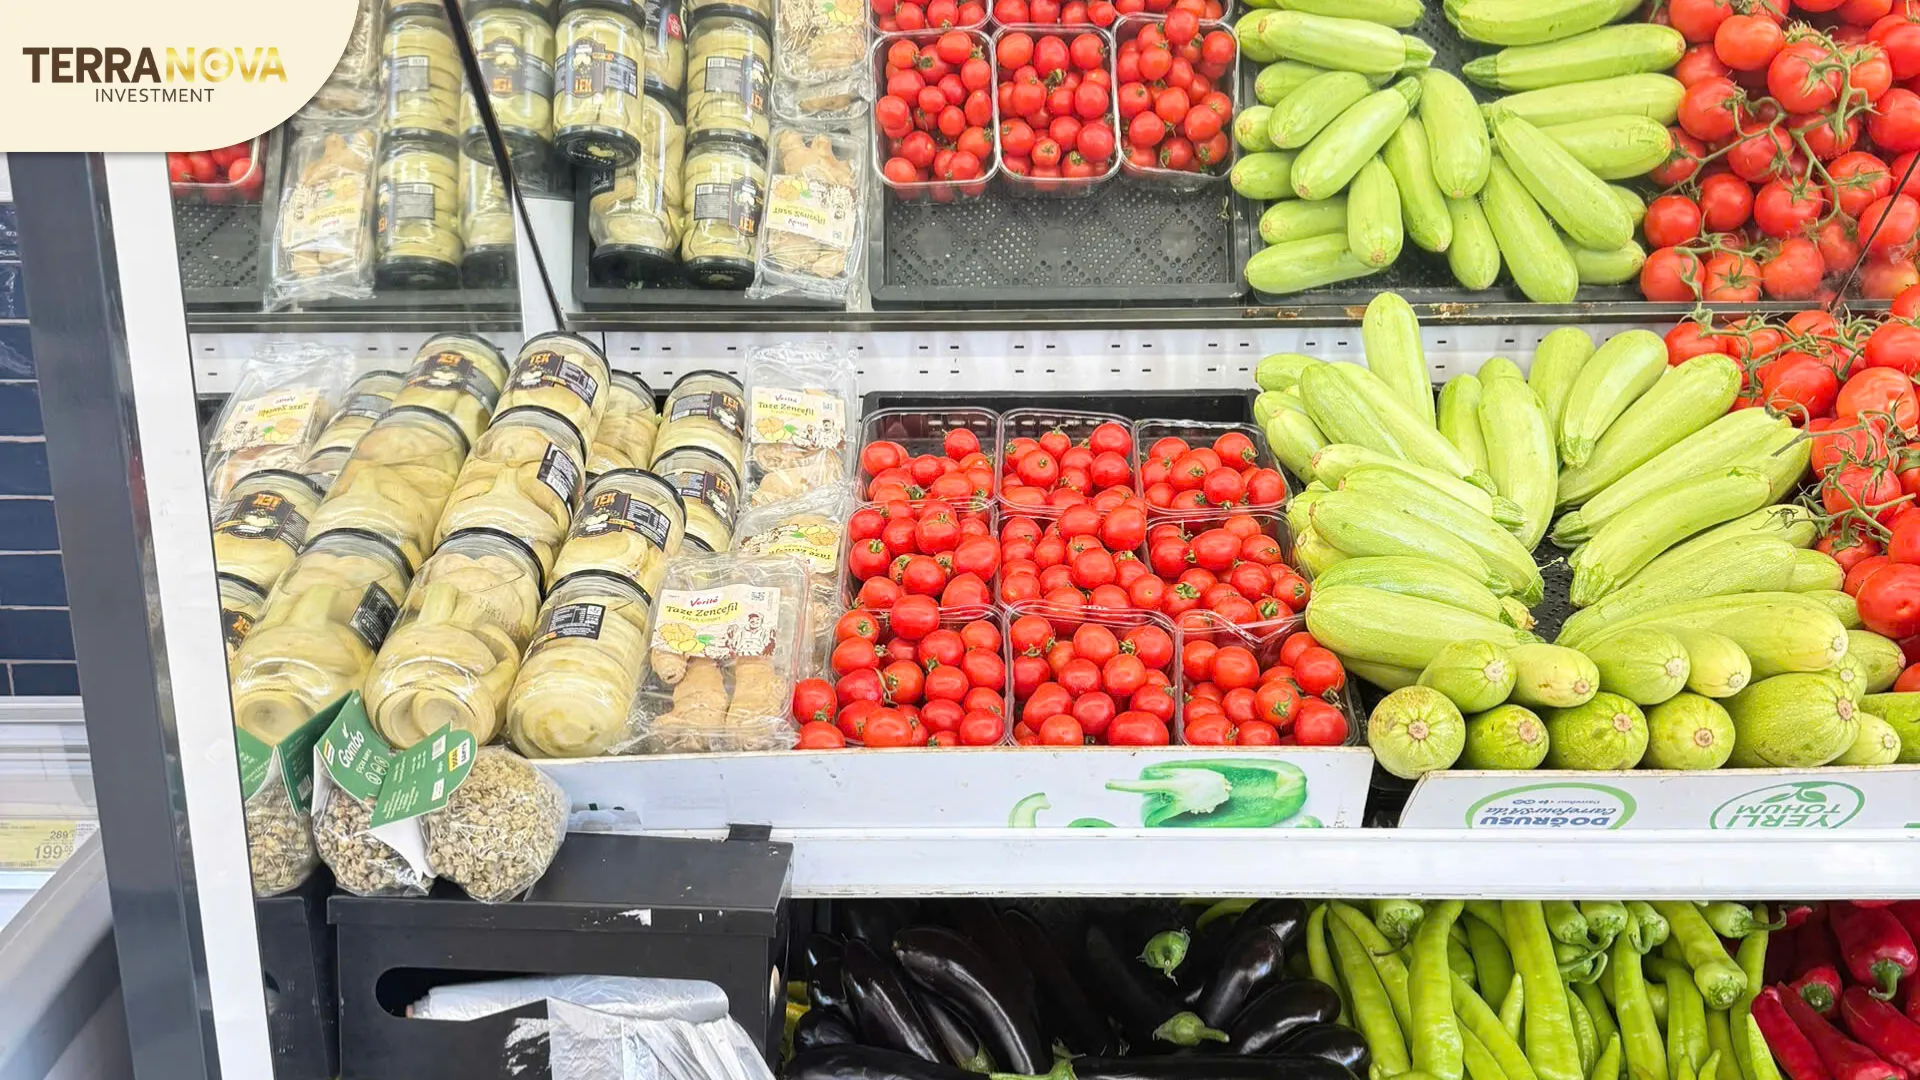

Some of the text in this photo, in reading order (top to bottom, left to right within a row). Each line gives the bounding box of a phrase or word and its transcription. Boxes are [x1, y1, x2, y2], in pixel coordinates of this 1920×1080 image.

[529, 352, 552, 367] TEK
[721, 393, 740, 411] TEK
[757, 401, 779, 411] Taze
[780, 402, 816, 417] Zencefil
[714, 477, 732, 496] TEK
[592, 492, 618, 511] TEK
[665, 602, 740, 617] Taze Zencefil
[337, 729, 365, 769] Gombo
[1735, 804, 1841, 814] TOHUM
[1479, 815, 1611, 828] DOĞRUSU
